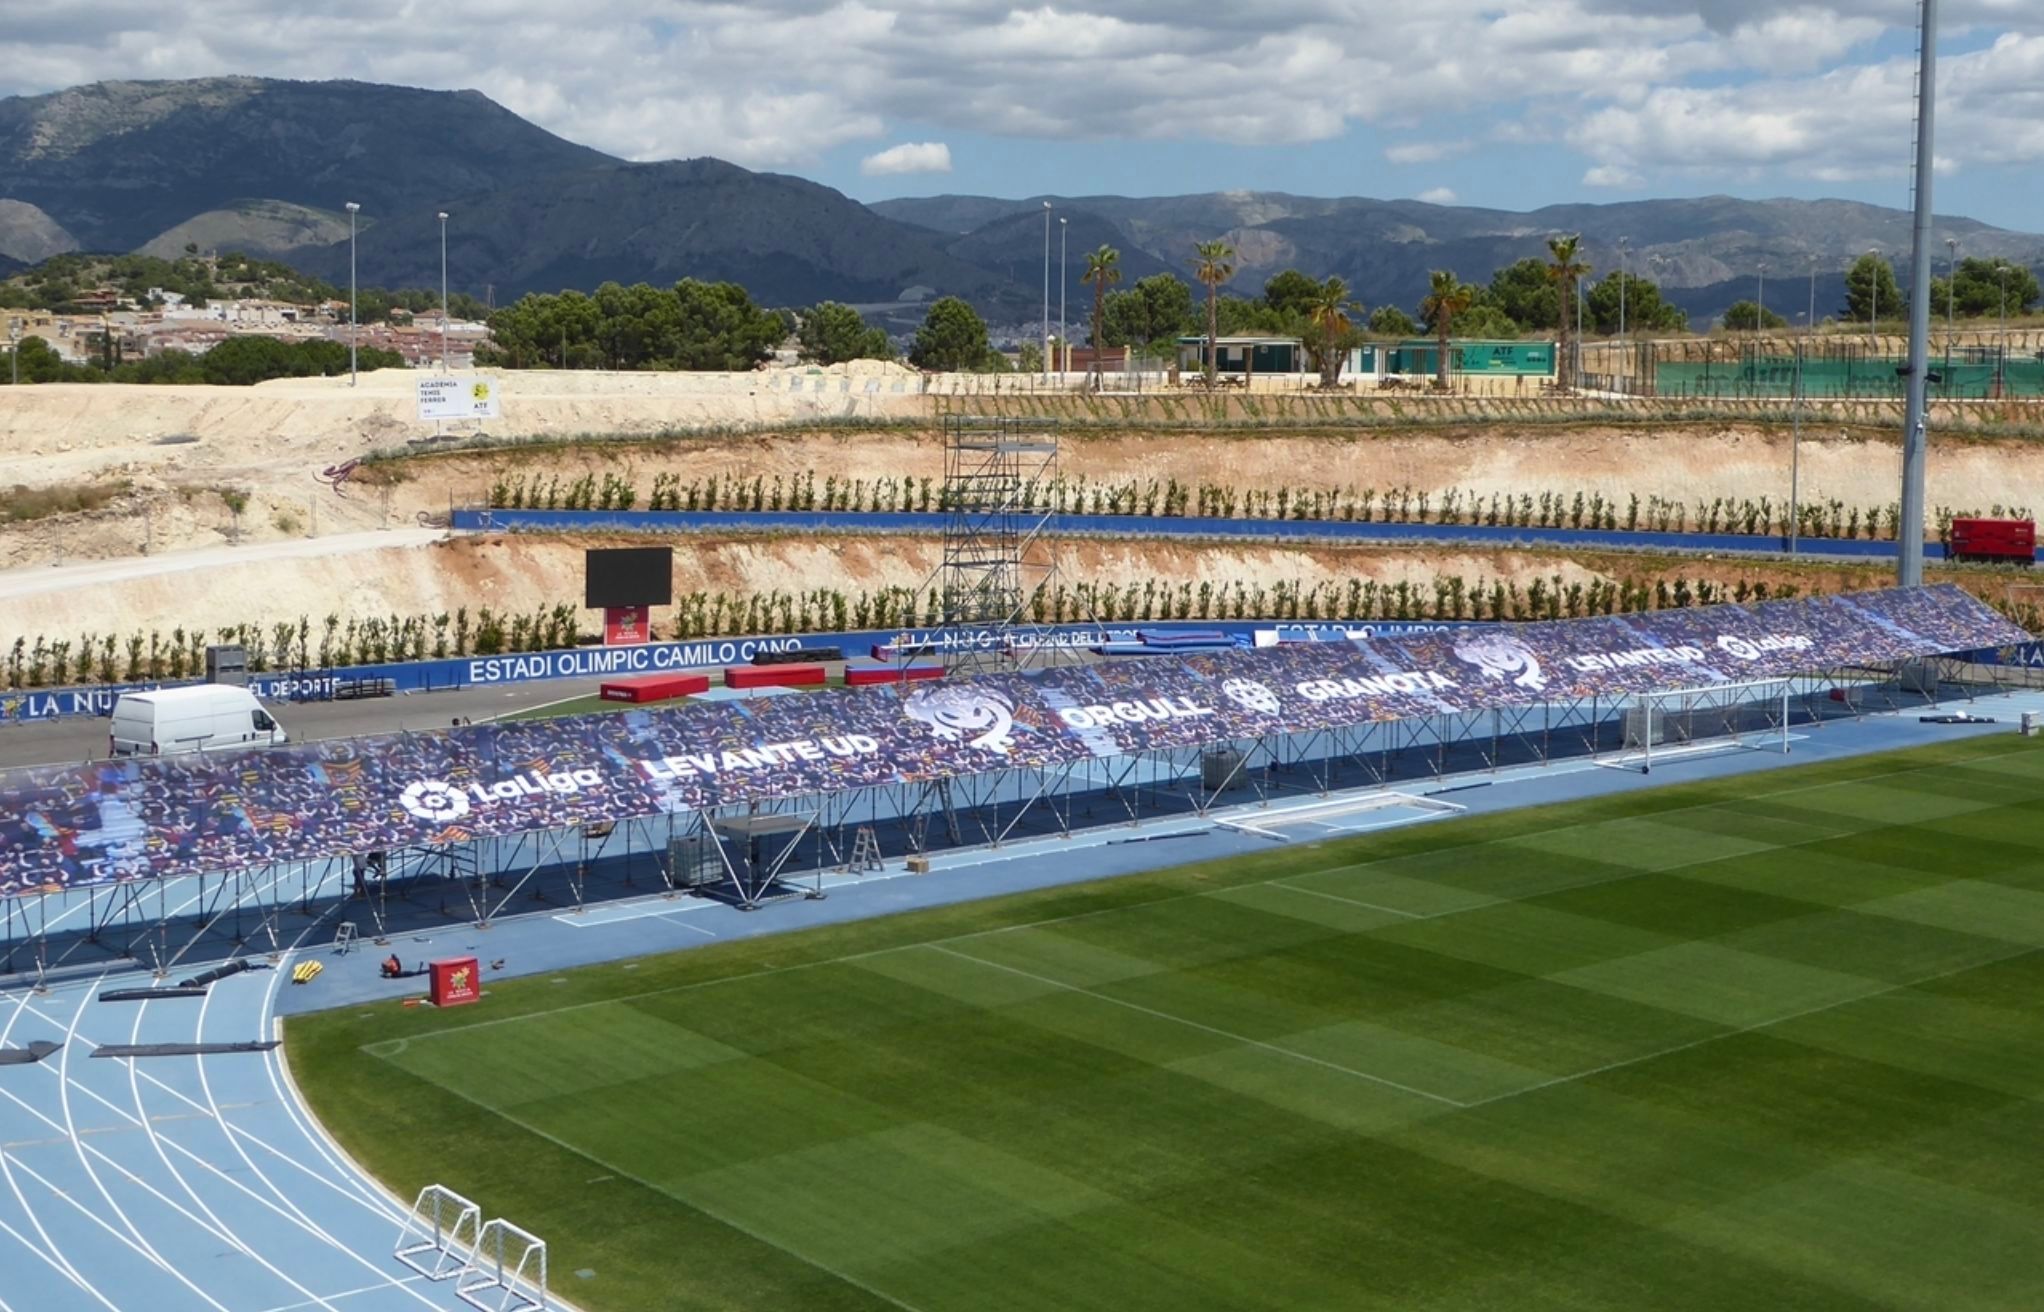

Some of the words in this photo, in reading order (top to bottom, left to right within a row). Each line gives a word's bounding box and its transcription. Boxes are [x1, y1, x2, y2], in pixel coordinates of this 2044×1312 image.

[1492, 346, 1513, 356] ATF
[470, 655, 551, 682] ESTADI
[558, 649, 648, 675] OLIMPIC
[653, 642, 736, 667] CAMILO
[1565, 648, 1673, 672] LEVANTE
[1666, 645, 1705, 662] UD
[1296, 670, 1462, 700] GRANOTA
[29, 694, 60, 716] LA
[1060, 696, 1214, 729] ORGULL
[640, 740, 825, 779] LEVANTE
[820, 734, 879, 757] UD
[470, 769, 603, 801] LaLiga
